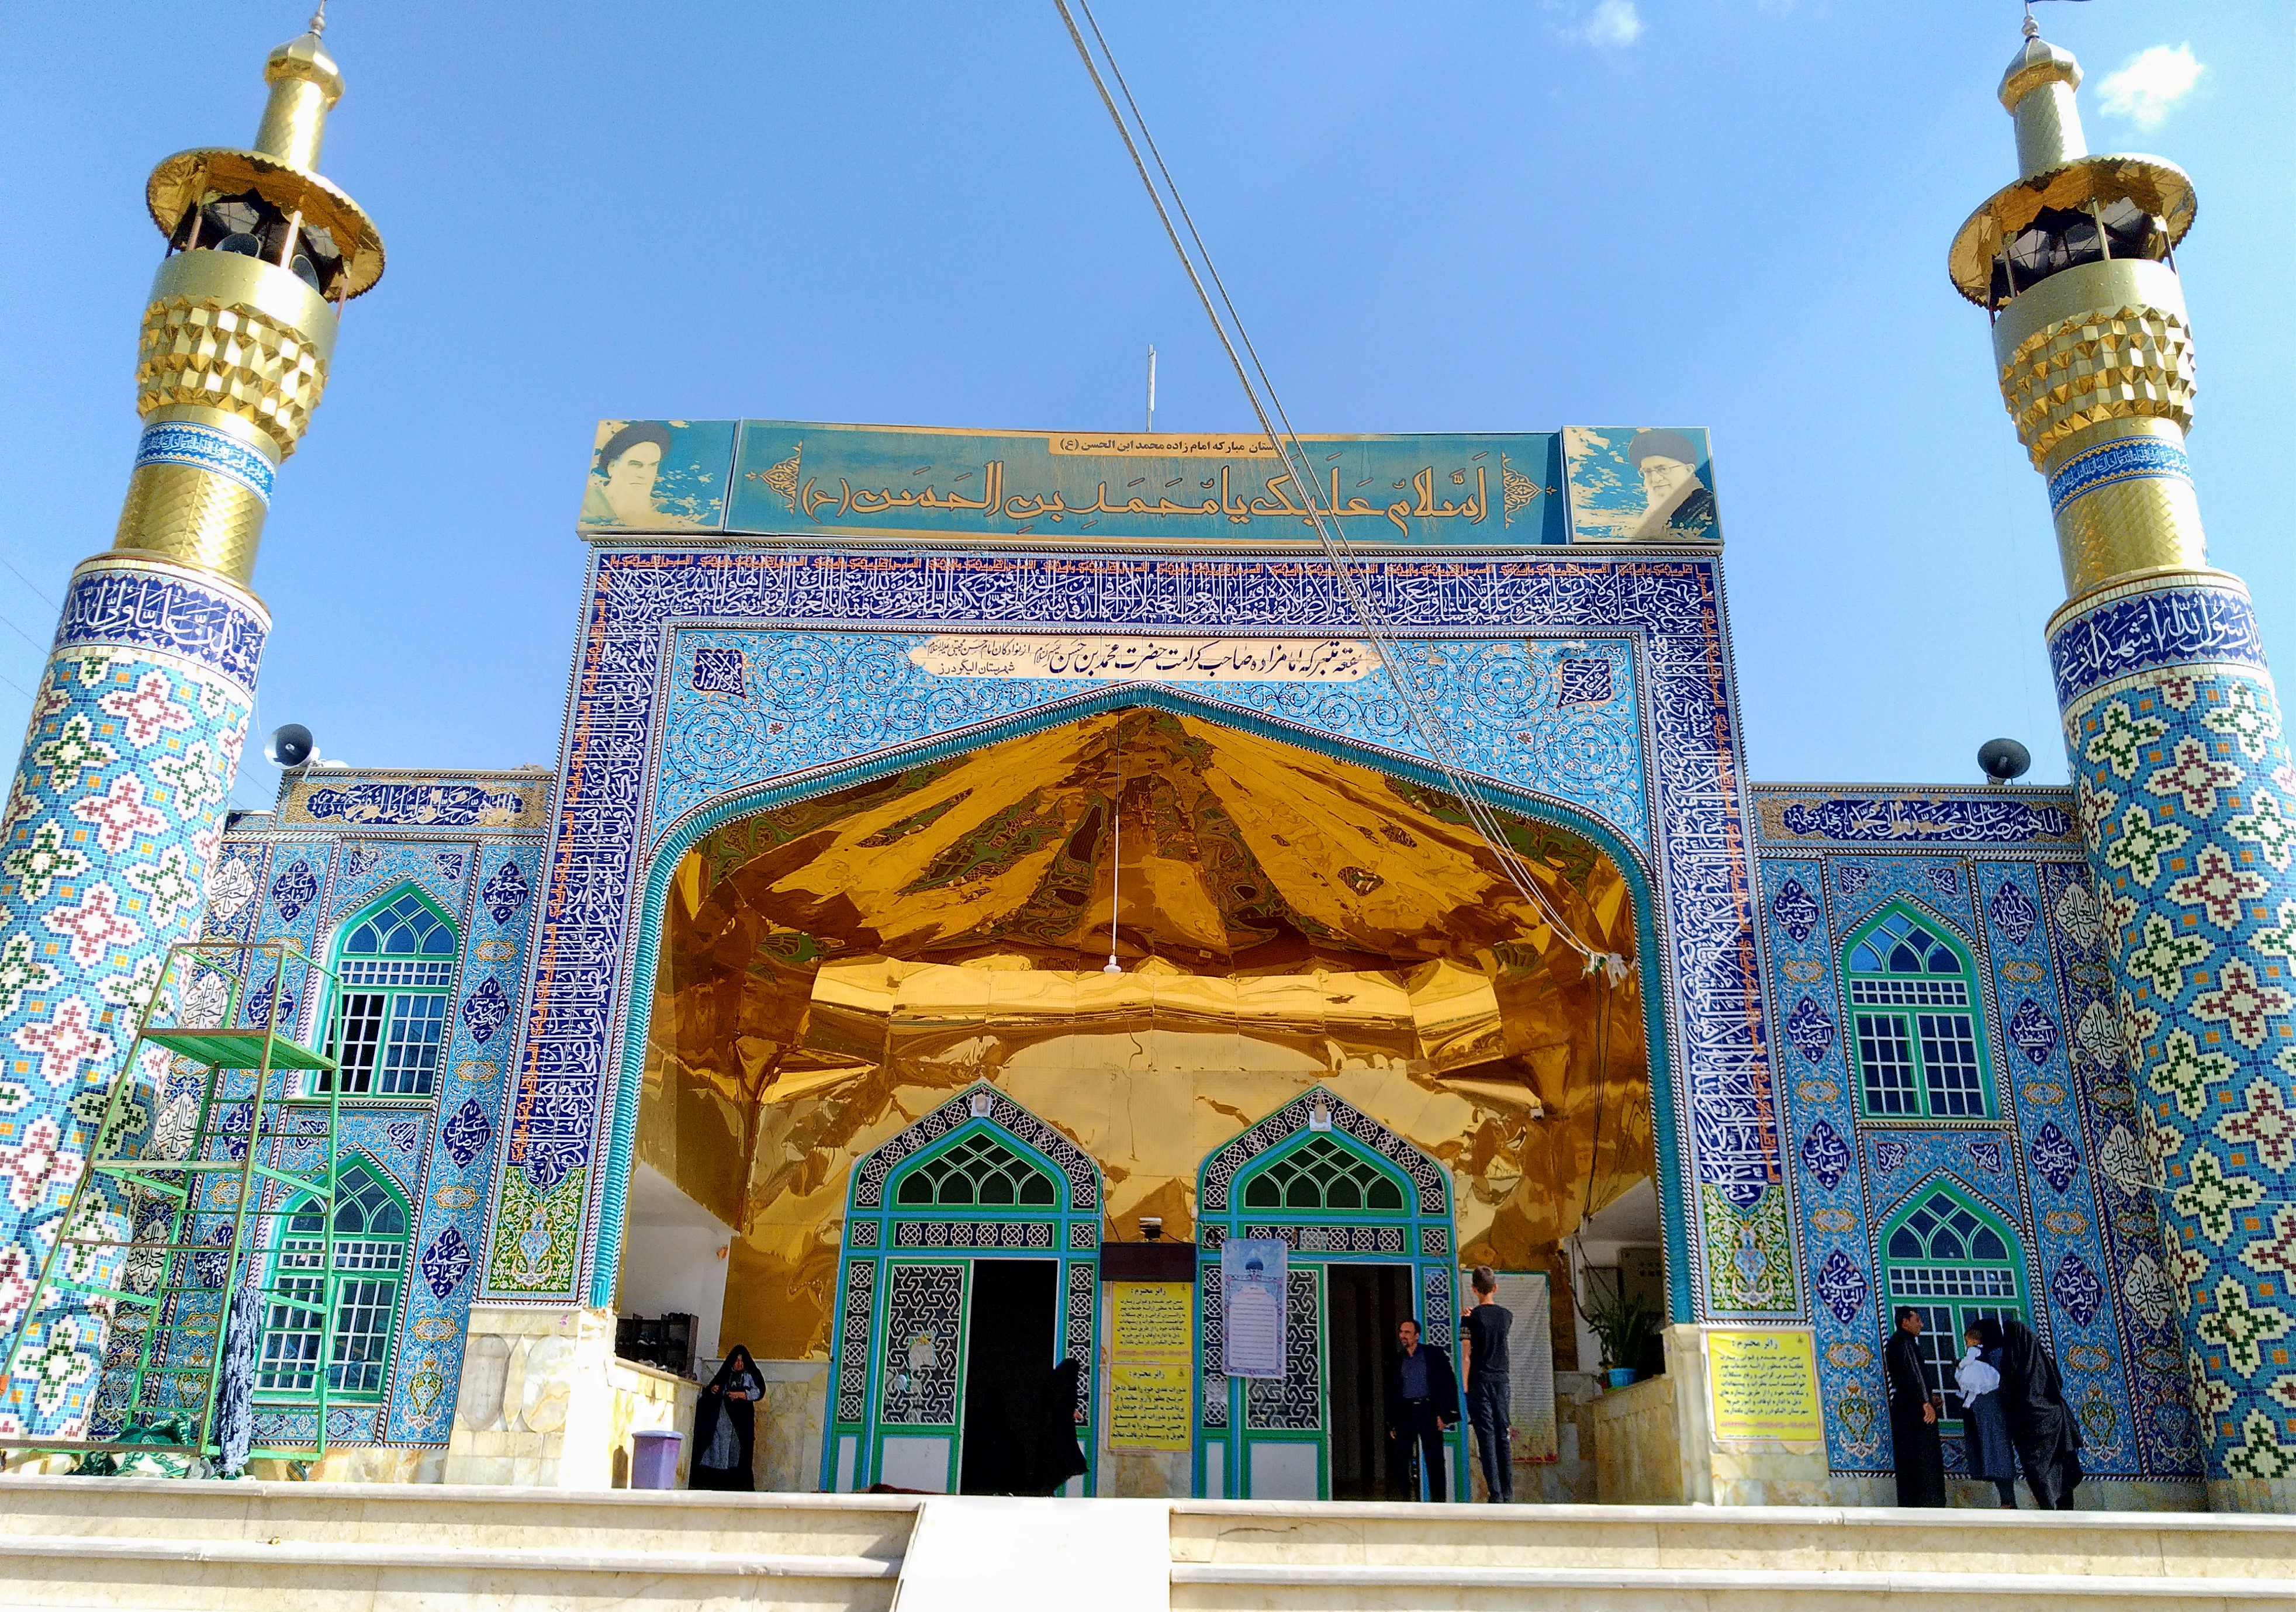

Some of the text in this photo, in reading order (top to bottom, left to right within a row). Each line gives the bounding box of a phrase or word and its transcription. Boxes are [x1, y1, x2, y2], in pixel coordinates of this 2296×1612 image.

[1081, 439, 1115, 451] الحسن
[1136, 441, 1164, 451] محمد
[978, 661, 1015, 675] شهرستان
